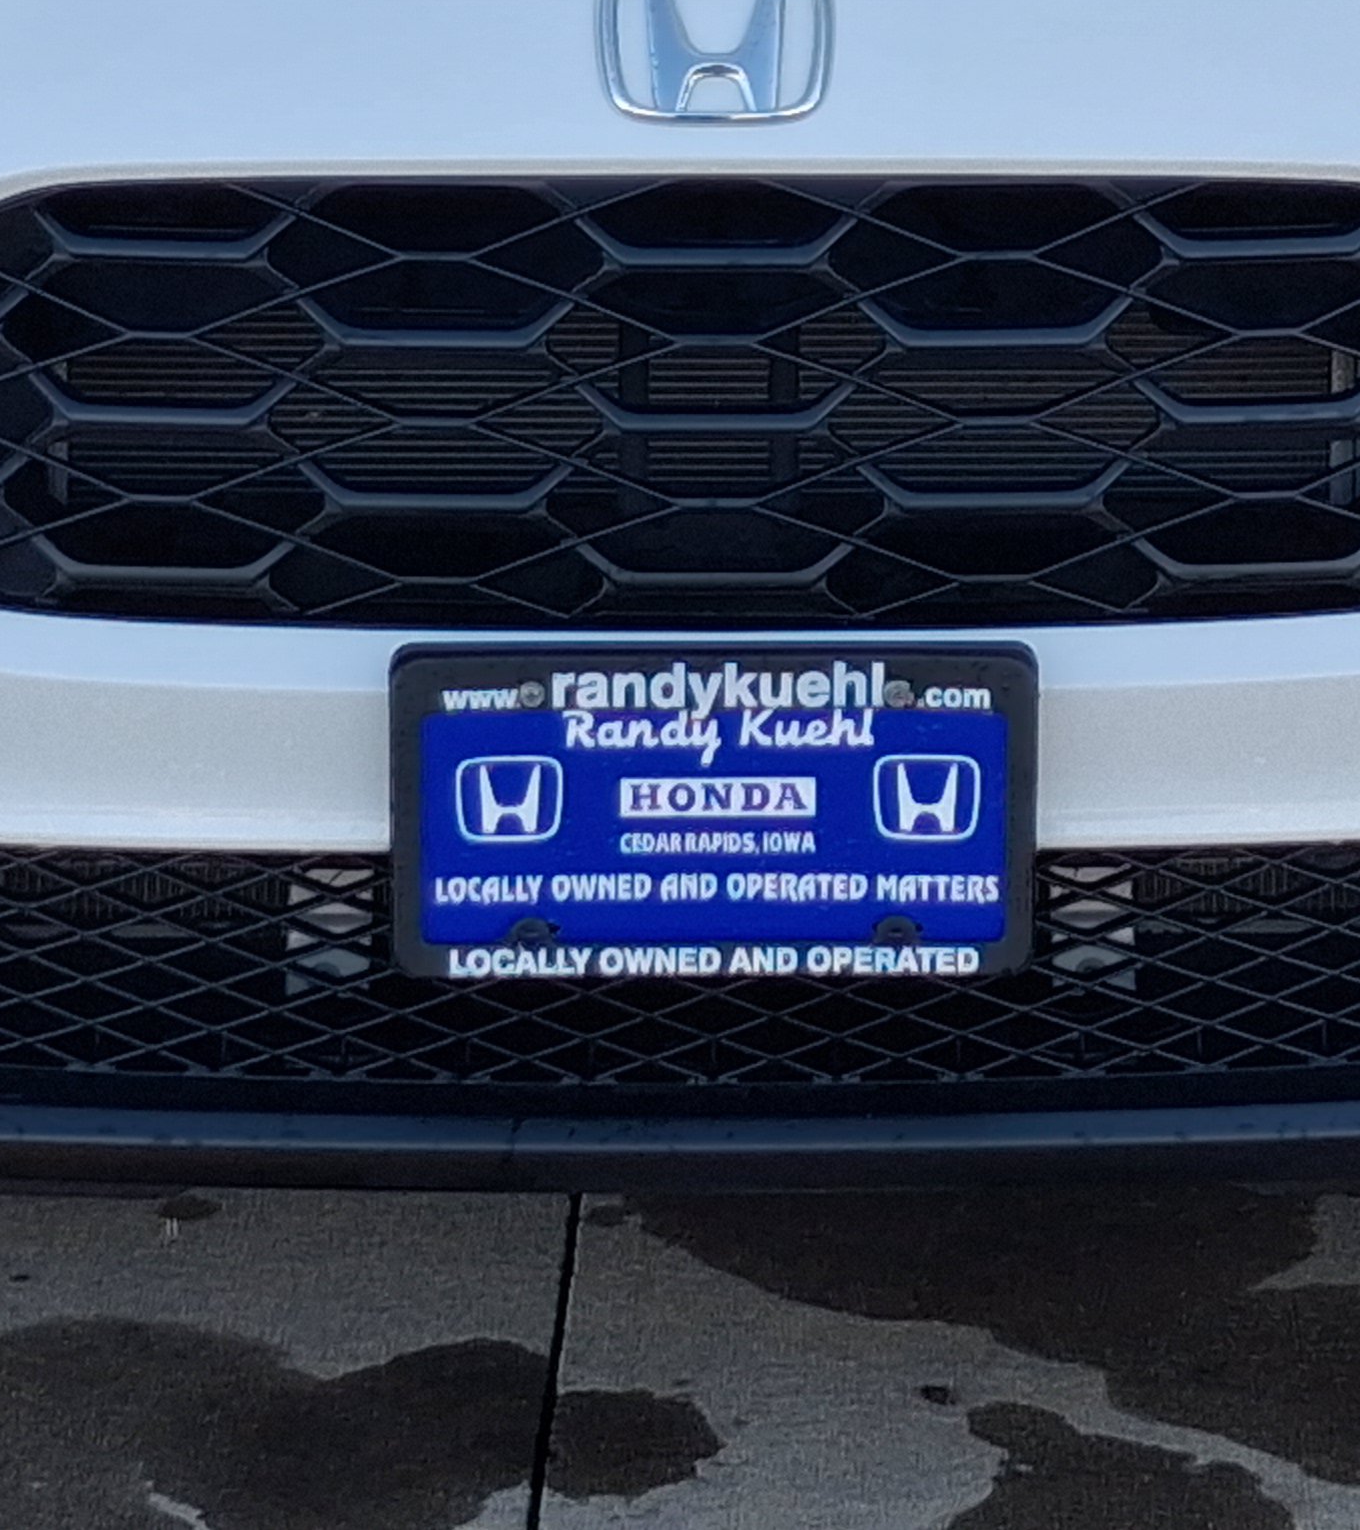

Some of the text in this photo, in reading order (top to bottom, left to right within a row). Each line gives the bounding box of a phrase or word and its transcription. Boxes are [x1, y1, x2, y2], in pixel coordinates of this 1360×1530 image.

[551, 661, 885, 721] randykuehl
[562, 708, 875, 768] Randy Kuehl
[629, 782, 808, 811] HONDA
[620, 831, 816, 855] CEDAR RAPIDS, IOWA
[435, 872, 999, 904] LOCALLY OWNED AND OPERATED MATTERS
[449, 946, 980, 977] LOCALLY OWNED AND OPERATED
